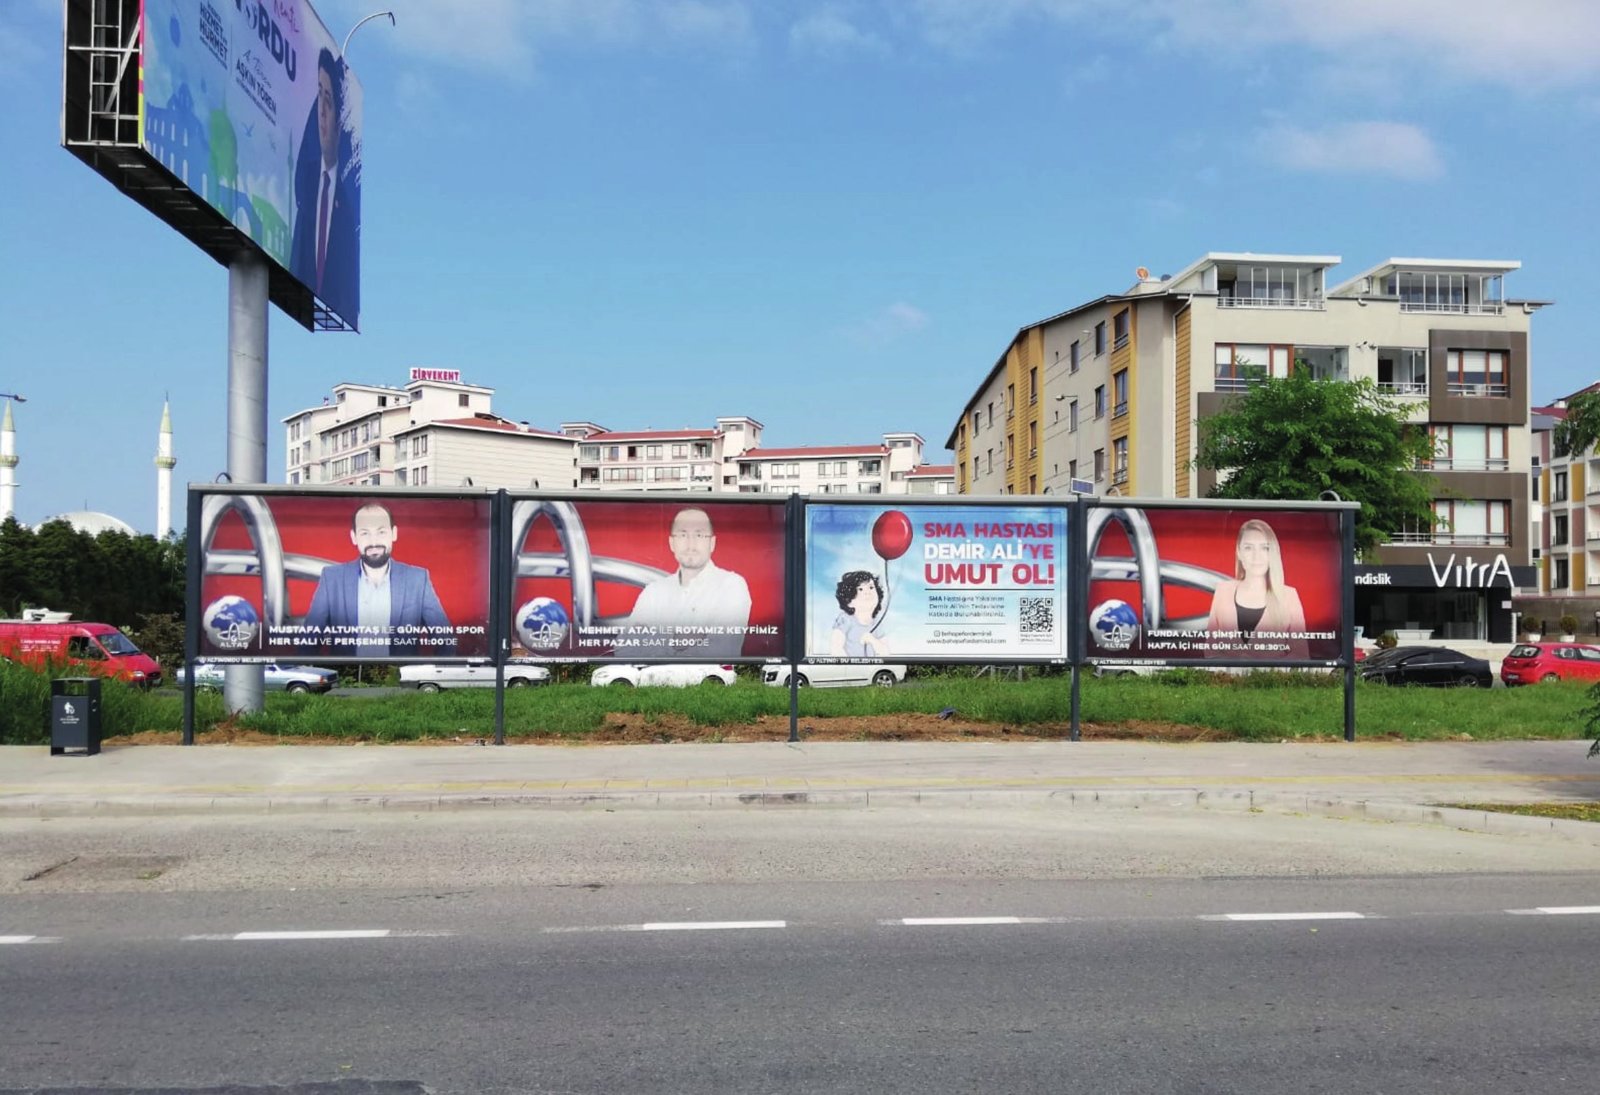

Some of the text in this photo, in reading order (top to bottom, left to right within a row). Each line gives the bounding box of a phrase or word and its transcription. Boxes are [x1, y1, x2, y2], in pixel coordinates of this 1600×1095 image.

[412, 367, 459, 380] ZİRVEKENT
[924, 523, 1054, 538] SMA HASTASI
[924, 540, 1054, 560] DEMİR ALİ'YE
[925, 563, 1055, 585] UMUT OL!
[1354, 573, 1392, 585] ndislik
[269, 625, 321, 634] MUSTAFA
[323, 625, 379, 636] ALTUNTAŞ
[396, 624, 453, 634] GÜNAYDIN
[456, 625, 485, 634] SPOR
[579, 626, 626, 635] MEHMET
[628, 626, 657, 636] ATAÇ
[675, 626, 724, 634] ROTAMIZ
[726, 624, 778, 635] KEYFİMİZ
[1181, 630, 1210, 639] ALTAŞ
[1257, 631, 1289, 639] EKRAN
[1291, 630, 1336, 639] GAZETESİ
[220, 642, 249, 650] ALTAŞ
[334, 638, 391, 647] PERŞEMBE
[532, 642, 560, 650] ALTAŞ
[579, 639, 600, 647] HER
[603, 639, 640, 647] PAZAR
[1148, 642, 1177, 650] HAFTA
[1179, 641, 1190, 651] İÇİ
[1192, 642, 1210, 650] HER
[1212, 641, 1231, 650] GÜN
